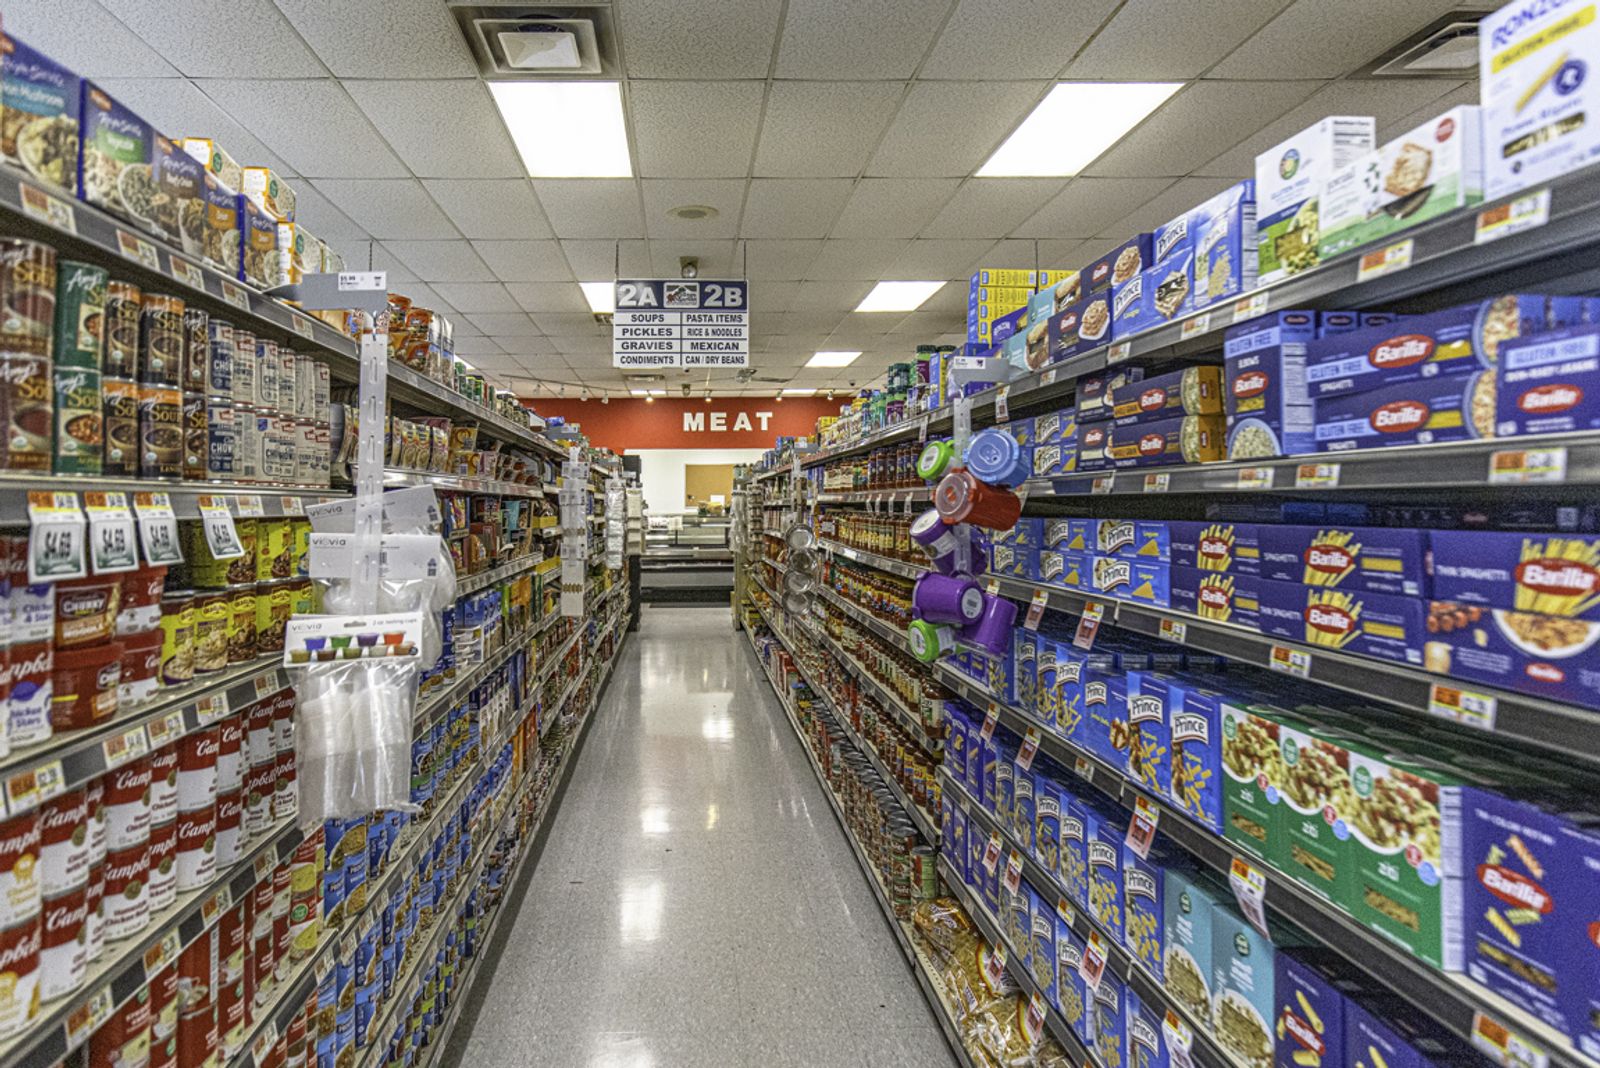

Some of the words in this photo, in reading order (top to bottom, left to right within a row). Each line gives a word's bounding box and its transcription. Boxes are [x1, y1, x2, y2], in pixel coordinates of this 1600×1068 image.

[1158, 222, 1186, 255] Prince
[619, 284, 658, 306] 2A
[704, 284, 743, 307] 2B
[1115, 281, 1140, 312] Prince
[631, 314, 665, 323] SOUPS
[686, 314, 714, 323] PASTA
[716, 314, 743, 323] ITEMS
[622, 328, 673, 336] PICKLES
[687, 328, 703, 336] RICE
[705, 328, 710, 336] &
[711, 328, 742, 337] NOODLES
[621, 341, 673, 350] GRAVIES
[690, 342, 739, 350] MEXICAN
[1376, 340, 1428, 363] Barilla
[620, 356, 674, 364] CONDIMENTS
[685, 356, 700, 364] CAN
[706, 356, 720, 364] DRY
[721, 356, 745, 364] BEANS
[1235, 376, 1266, 393] Barilla
[1141, 391, 1165, 408] Barilla
[1523, 388, 1577, 408] Barilla
[683, 411, 773, 432] MEAT
[1376, 408, 1422, 427] Barilla
[1140, 438, 1165, 451] Barilla
[1108, 525, 1132, 546] Prince
[1202, 540, 1228, 554] Barilla
[1263, 552, 1299, 563] SPAGHETTI
[1309, 551, 1349, 568] Barilla
[1104, 566, 1128, 585] Prince
[1458, 567, 1510, 581] SPAGHETTI
[1523, 565, 1596, 590] Barilla
[1202, 589, 1228, 603] Barilla
[1309, 610, 1349, 630] Barilla
[1059, 664, 1078, 680] Prince
[1087, 684, 1105, 699] Prince
[1132, 698, 1160, 715] Prince
[1174, 715, 1206, 737] Prince
[1038, 798, 1058, 813] Prince
[1063, 818, 1083, 835] Prince
[1091, 844, 1114, 862] Prince
[1127, 871, 1154, 895] Prince
[1483, 868, 1545, 910] Barilla
[1134, 1021, 1157, 1047] Prince
[1285, 1014, 1321, 1051] Barilla
